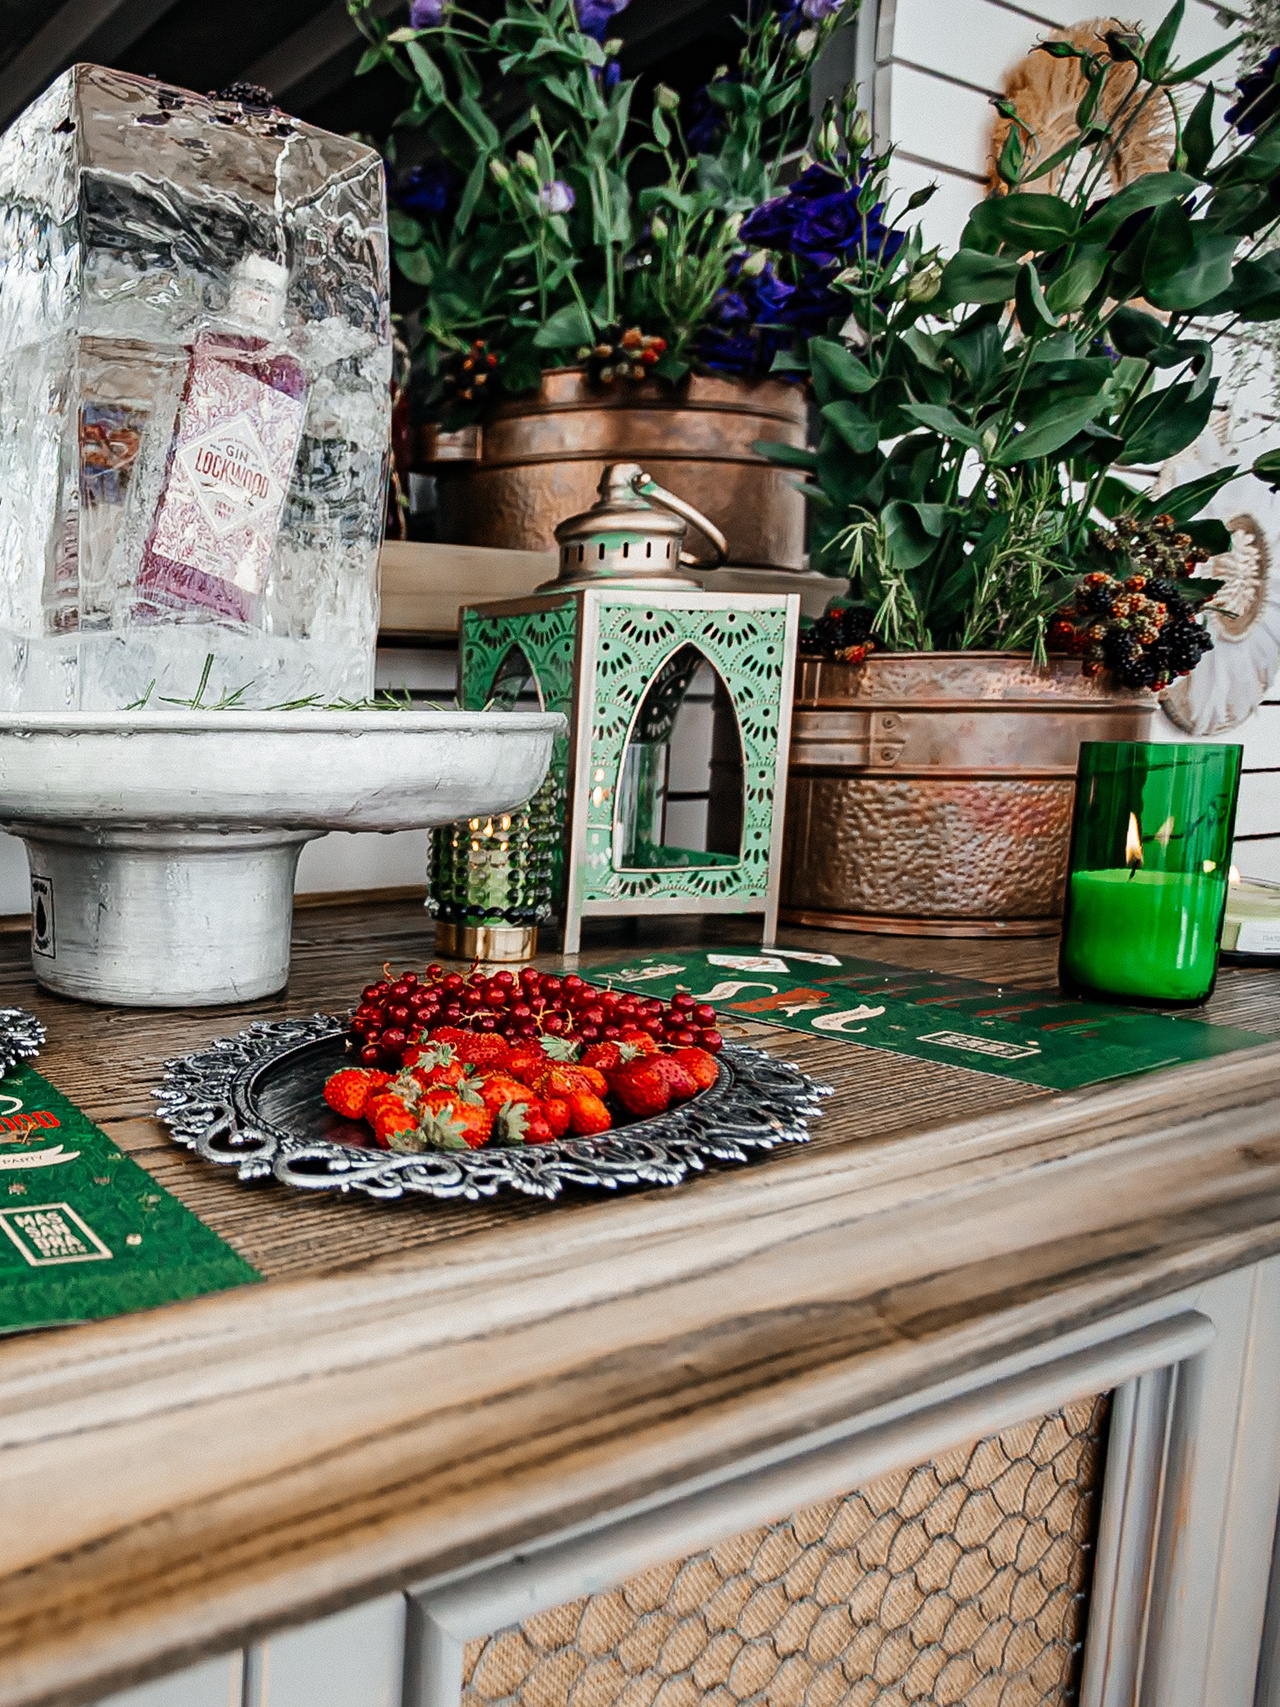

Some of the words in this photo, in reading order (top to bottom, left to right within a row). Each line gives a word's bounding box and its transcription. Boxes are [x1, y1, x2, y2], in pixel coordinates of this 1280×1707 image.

[226, 445, 249, 463] GIN
[195, 448, 269, 499] LOCKWOOD
[2, 1155, 43, 1165] PARTY
[14, 1211, 63, 1229] MAS
[24, 1222, 71, 1239] SAN
